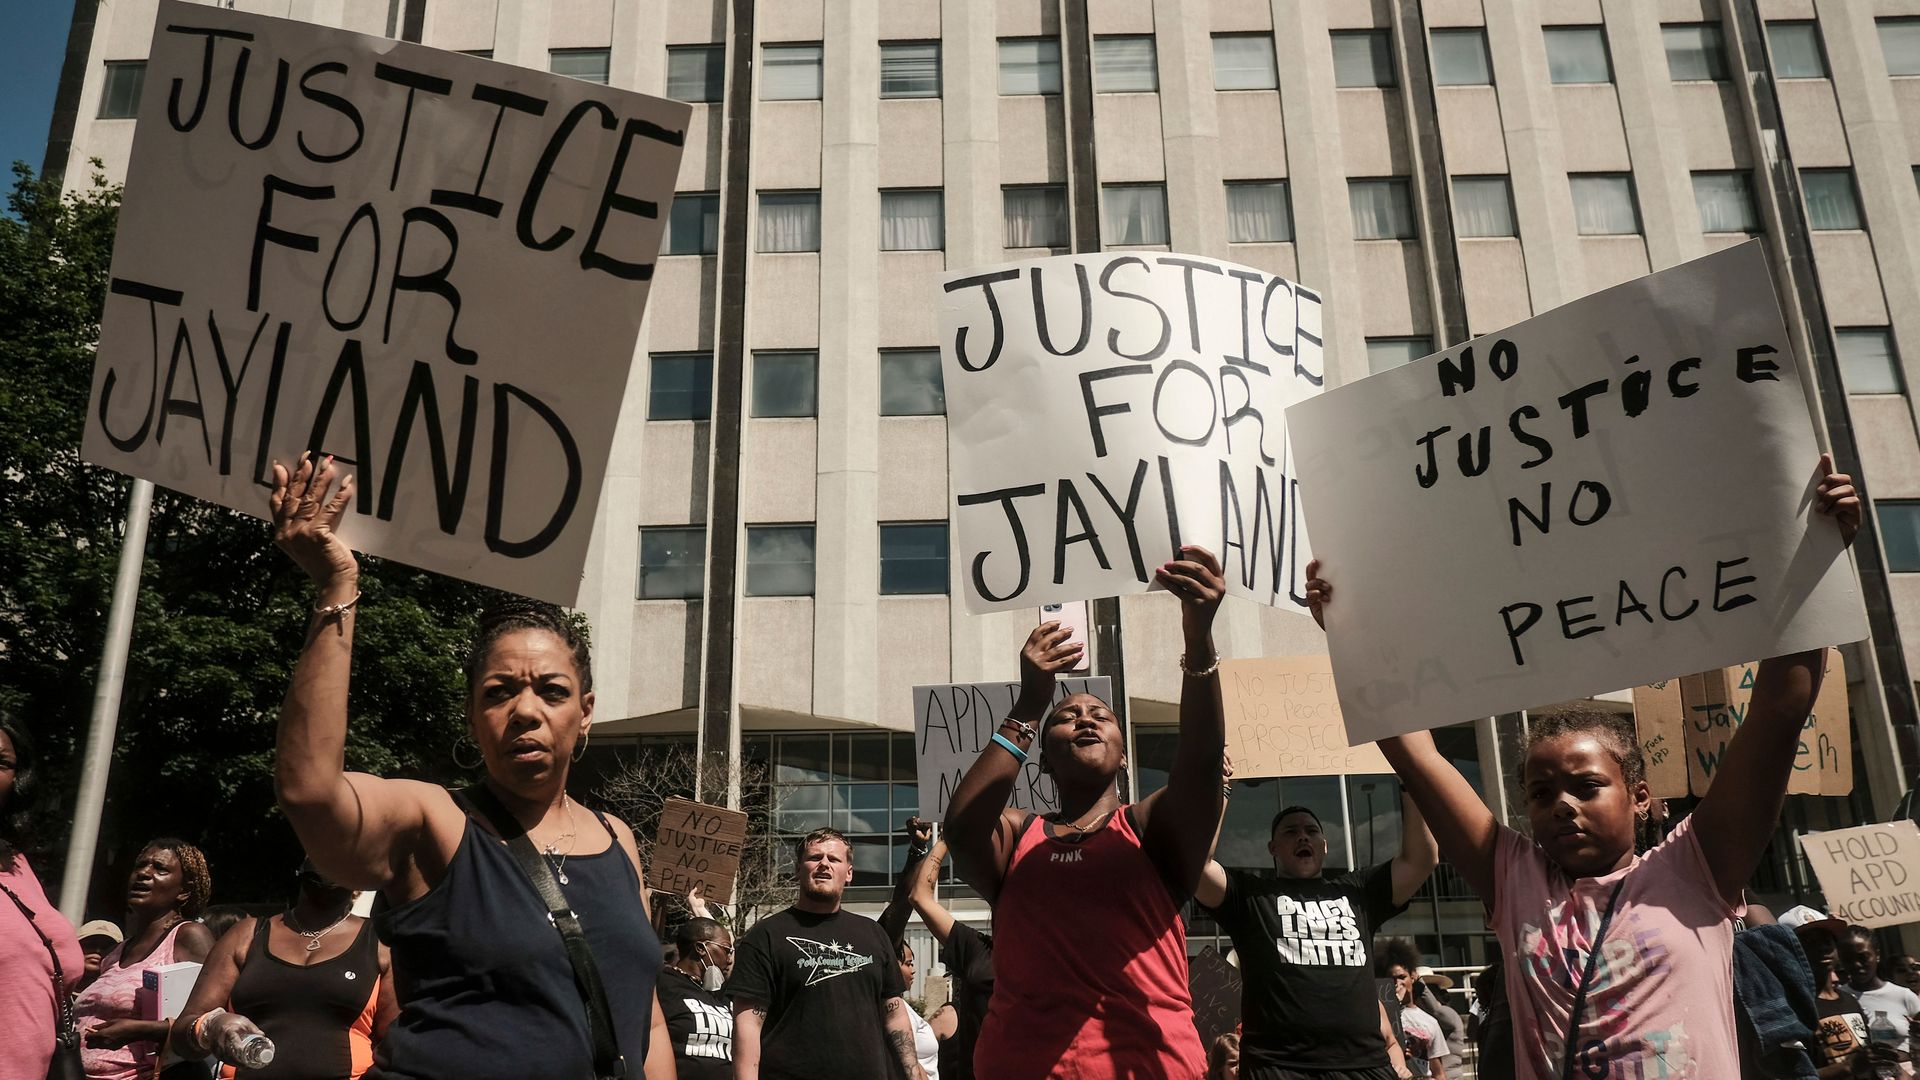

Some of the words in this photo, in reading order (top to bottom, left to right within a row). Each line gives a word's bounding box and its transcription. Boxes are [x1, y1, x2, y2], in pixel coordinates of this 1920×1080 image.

[167, 23, 684, 281] JUSTICE
[247, 174, 478, 365] FOR
[943, 256, 1323, 386] JUSTICE
[1437, 339, 1519, 397] NO
[100, 277, 582, 559] JAYLAND
[1079, 359, 1275, 467] FOR
[1508, 480, 1612, 546] NO
[1499, 556, 1758, 666] PEACE
[1234, 671, 1265, 698] NO
[922, 685, 994, 755] APD
[681, 810, 722, 835] NO
[660, 828, 740, 857] JUSTICE
[1050, 849, 1082, 862] PINK
[1824, 832, 1898, 864] HOLD
[676, 852, 709, 873] NO
[1850, 860, 1908, 894] APD
[660, 867, 716, 899] PEACE
[1277, 895, 1356, 920] BLACK
[1281, 914, 1360, 940] LIVES
[1277, 938, 1367, 966] MATTER
